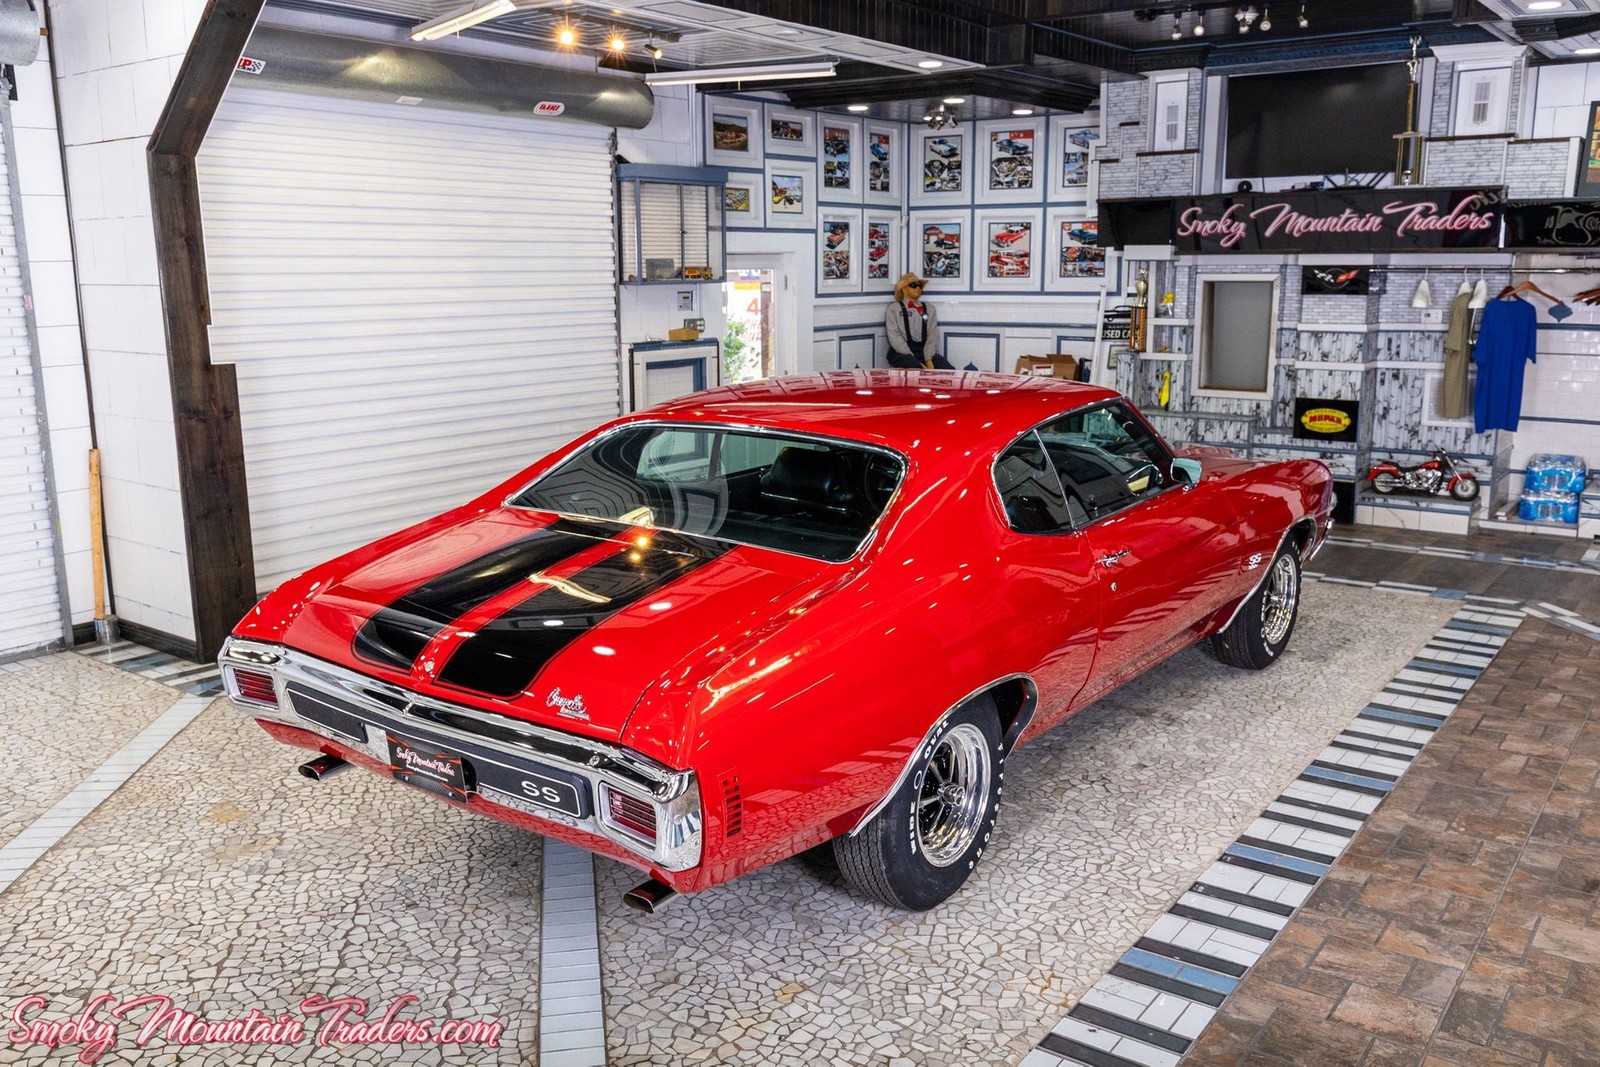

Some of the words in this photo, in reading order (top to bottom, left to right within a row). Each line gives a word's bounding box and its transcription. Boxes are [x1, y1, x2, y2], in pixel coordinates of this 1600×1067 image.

[1177, 203, 1246, 247] Smoky
[1250, 203, 1384, 238] Mountain
[1382, 194, 1495, 237] Traders
[1102, 329, 1121, 339] USED
[923, 720, 949, 760] OVAL
[521, 780, 561, 803] SS
